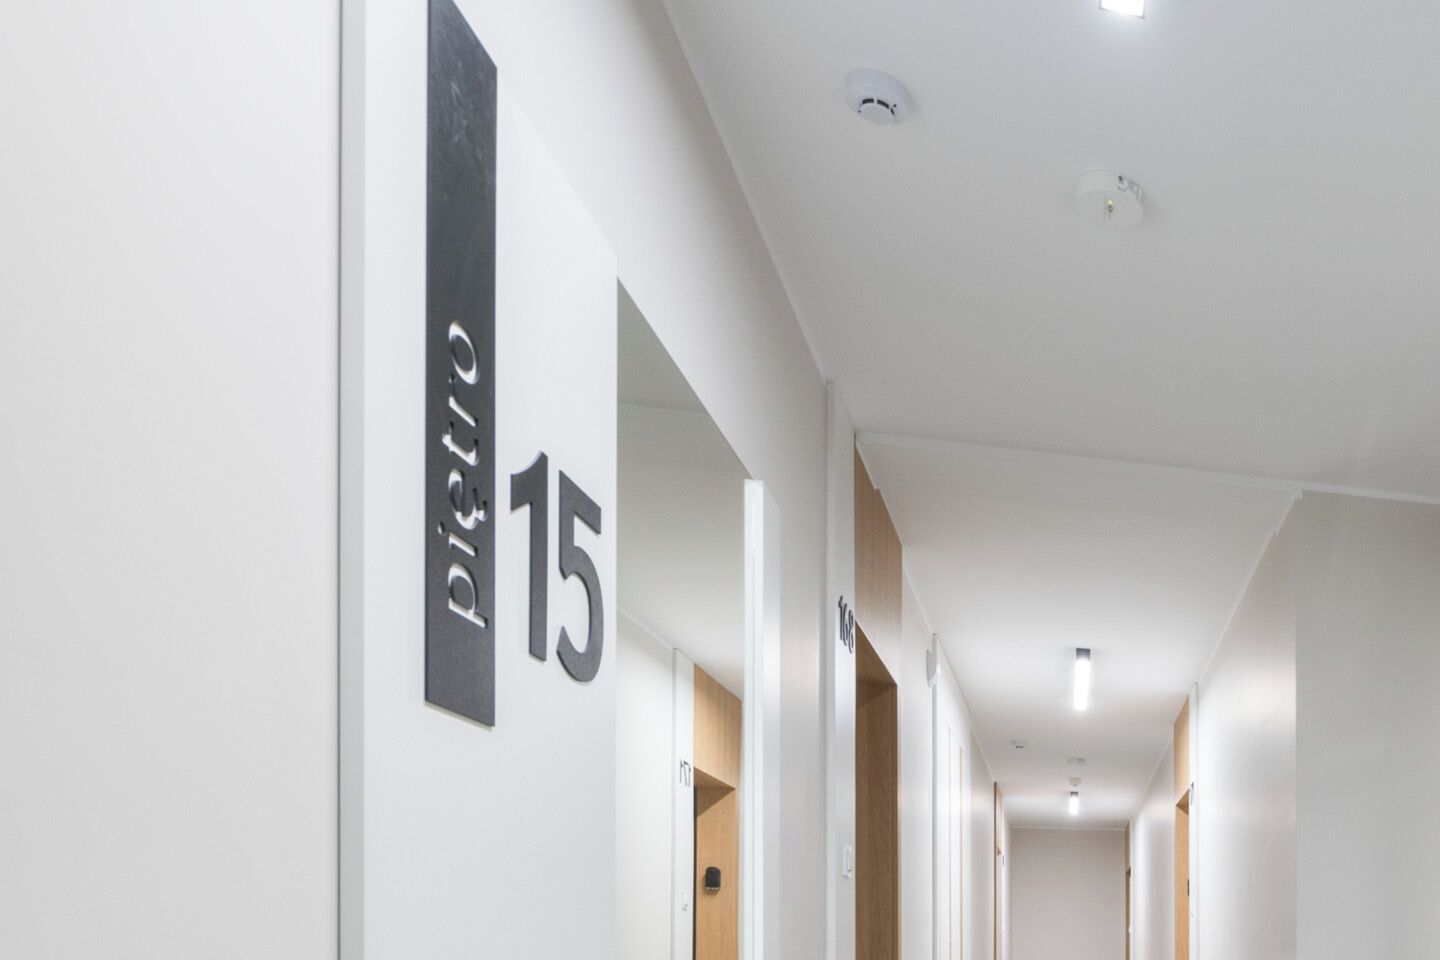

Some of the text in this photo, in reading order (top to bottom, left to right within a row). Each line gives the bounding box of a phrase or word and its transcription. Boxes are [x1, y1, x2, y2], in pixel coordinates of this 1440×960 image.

[437, 320, 489, 629] piętro
[510, 449, 604, 683] 15
[838, 595, 854, 654] 168
